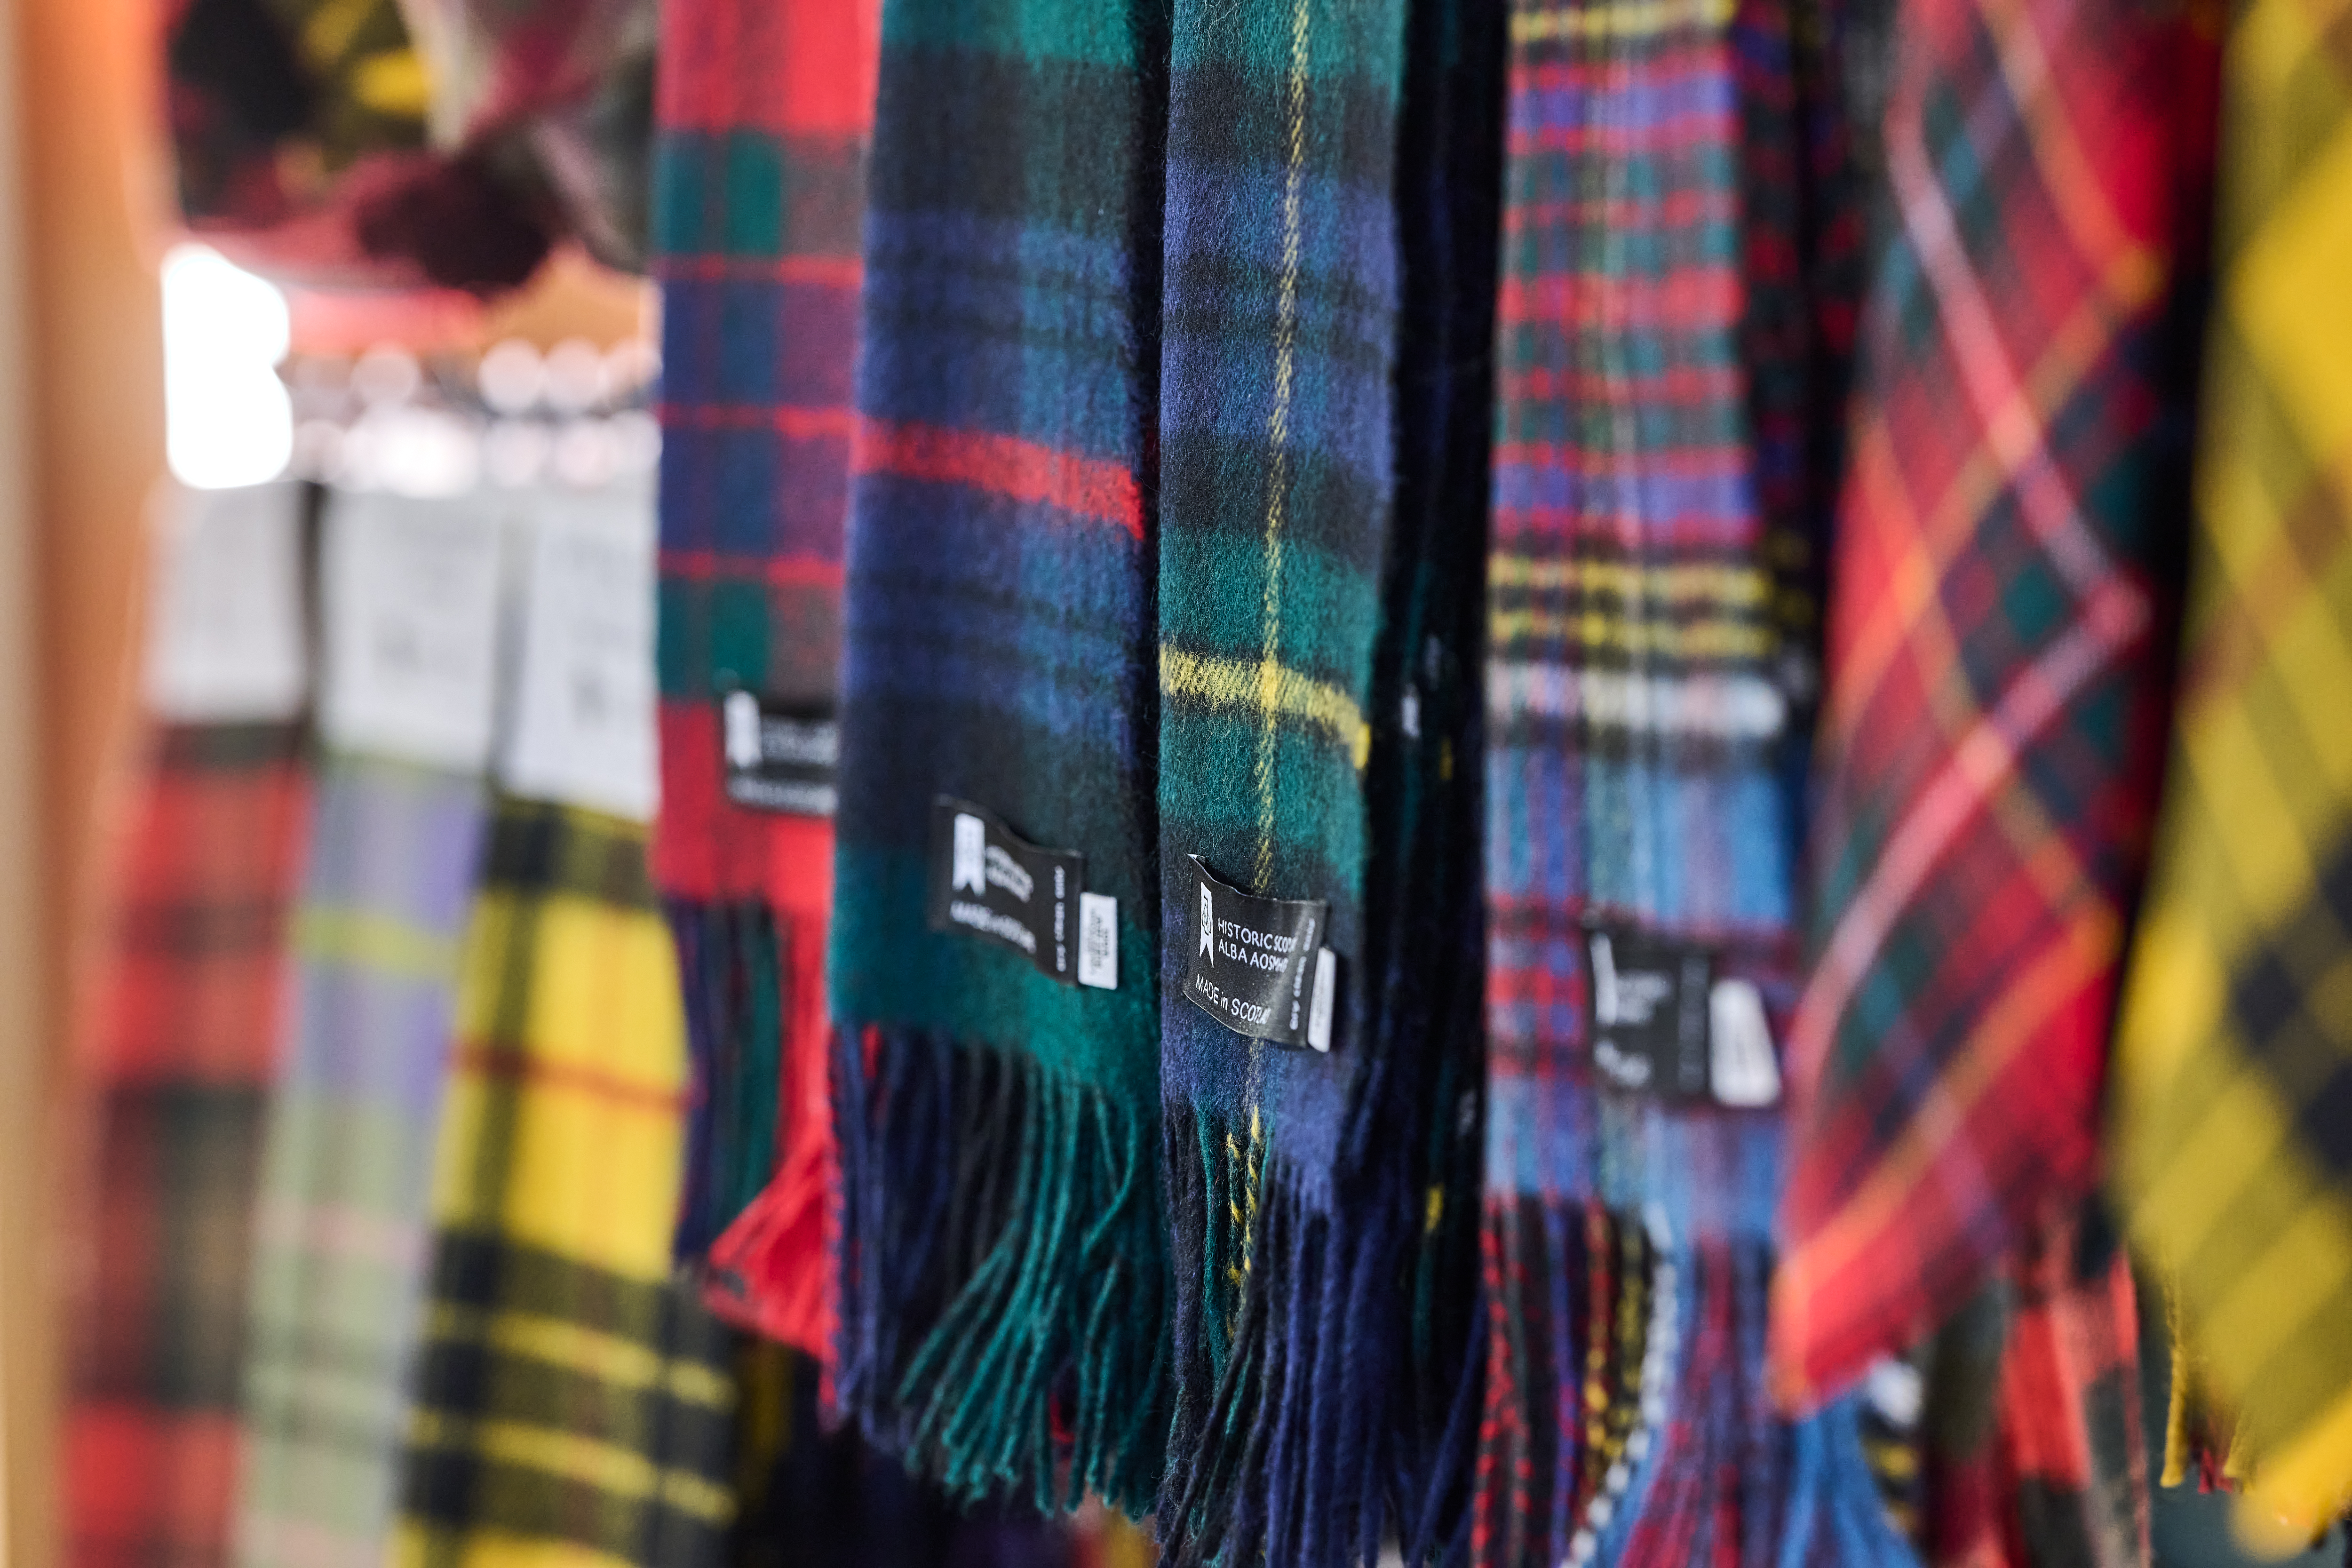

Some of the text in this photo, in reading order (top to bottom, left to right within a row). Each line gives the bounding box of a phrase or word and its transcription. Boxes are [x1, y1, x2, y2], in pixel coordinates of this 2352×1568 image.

[1218, 917, 1273, 949] HISTORIC
[1218, 939, 1248, 963] ALBA
[1196, 973, 1219, 1005] MADE
[1221, 991, 1228, 1011] in
